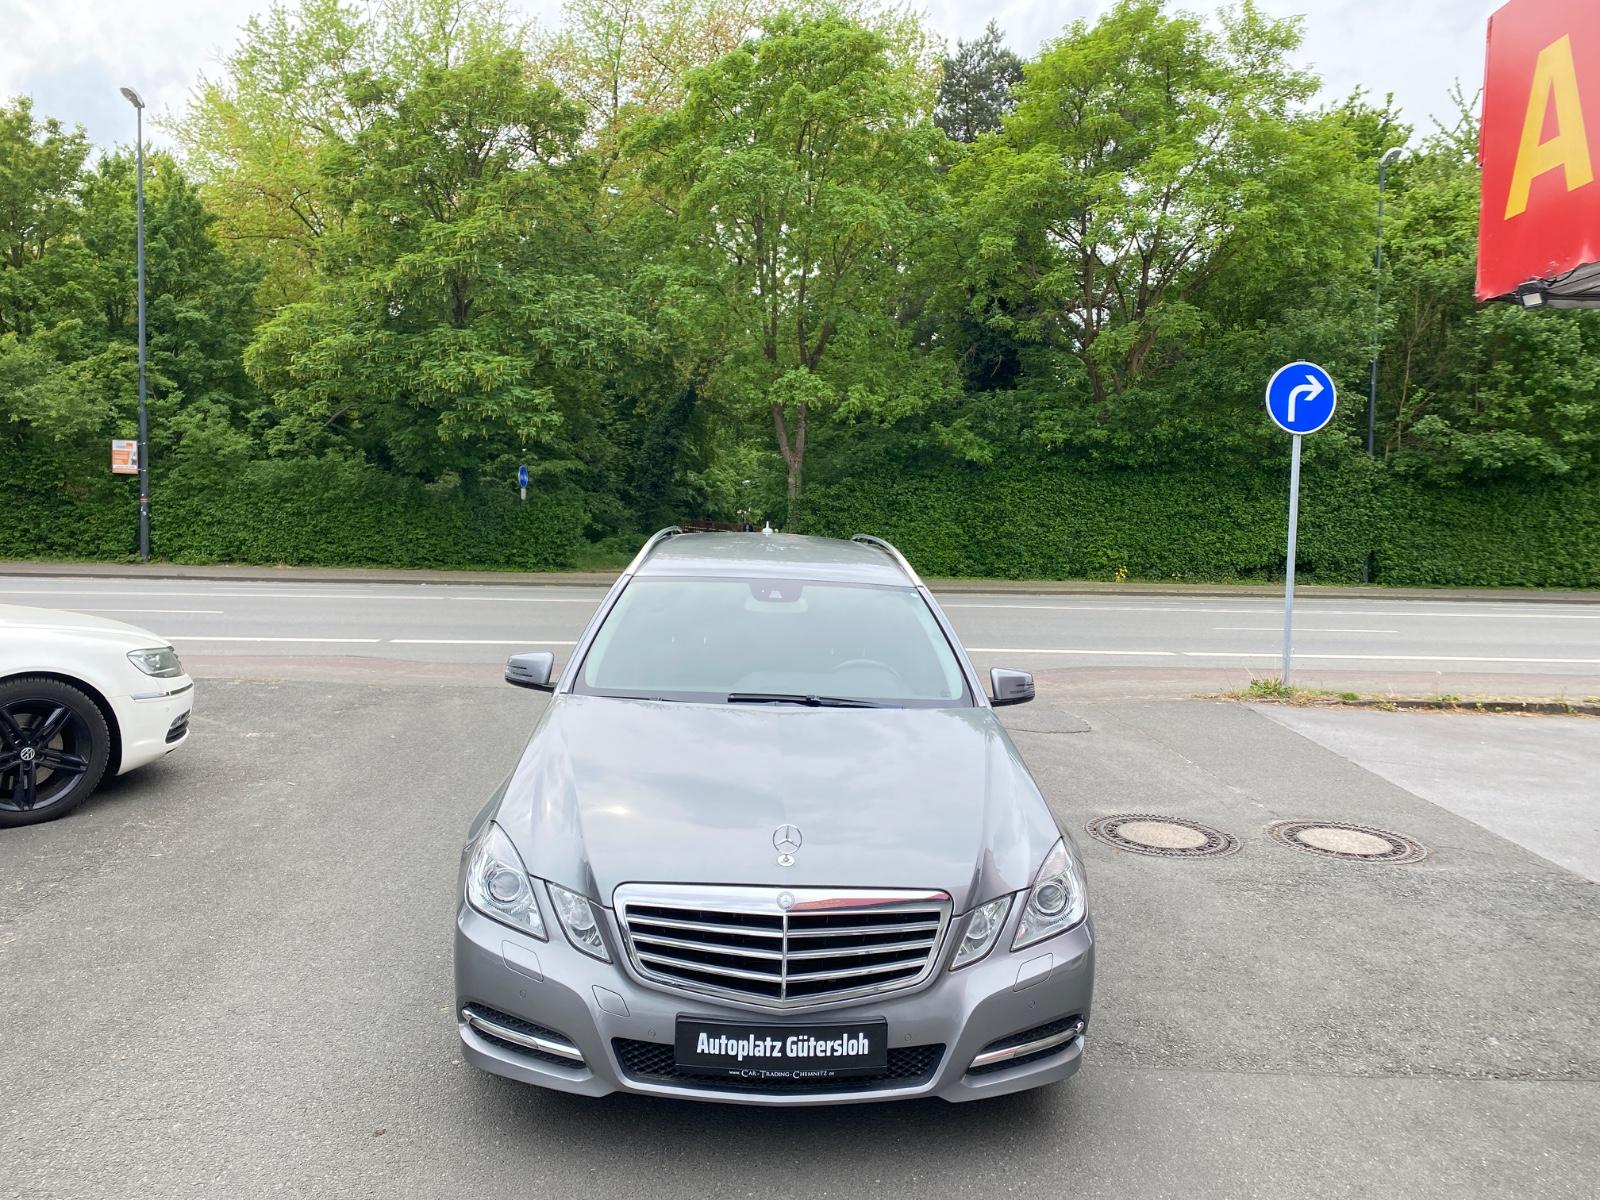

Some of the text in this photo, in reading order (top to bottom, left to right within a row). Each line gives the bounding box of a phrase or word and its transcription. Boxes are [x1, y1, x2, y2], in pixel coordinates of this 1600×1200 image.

[1504, 33, 1594, 221] A
[697, 1033, 869, 1061] Autoplatz Gütersloh
